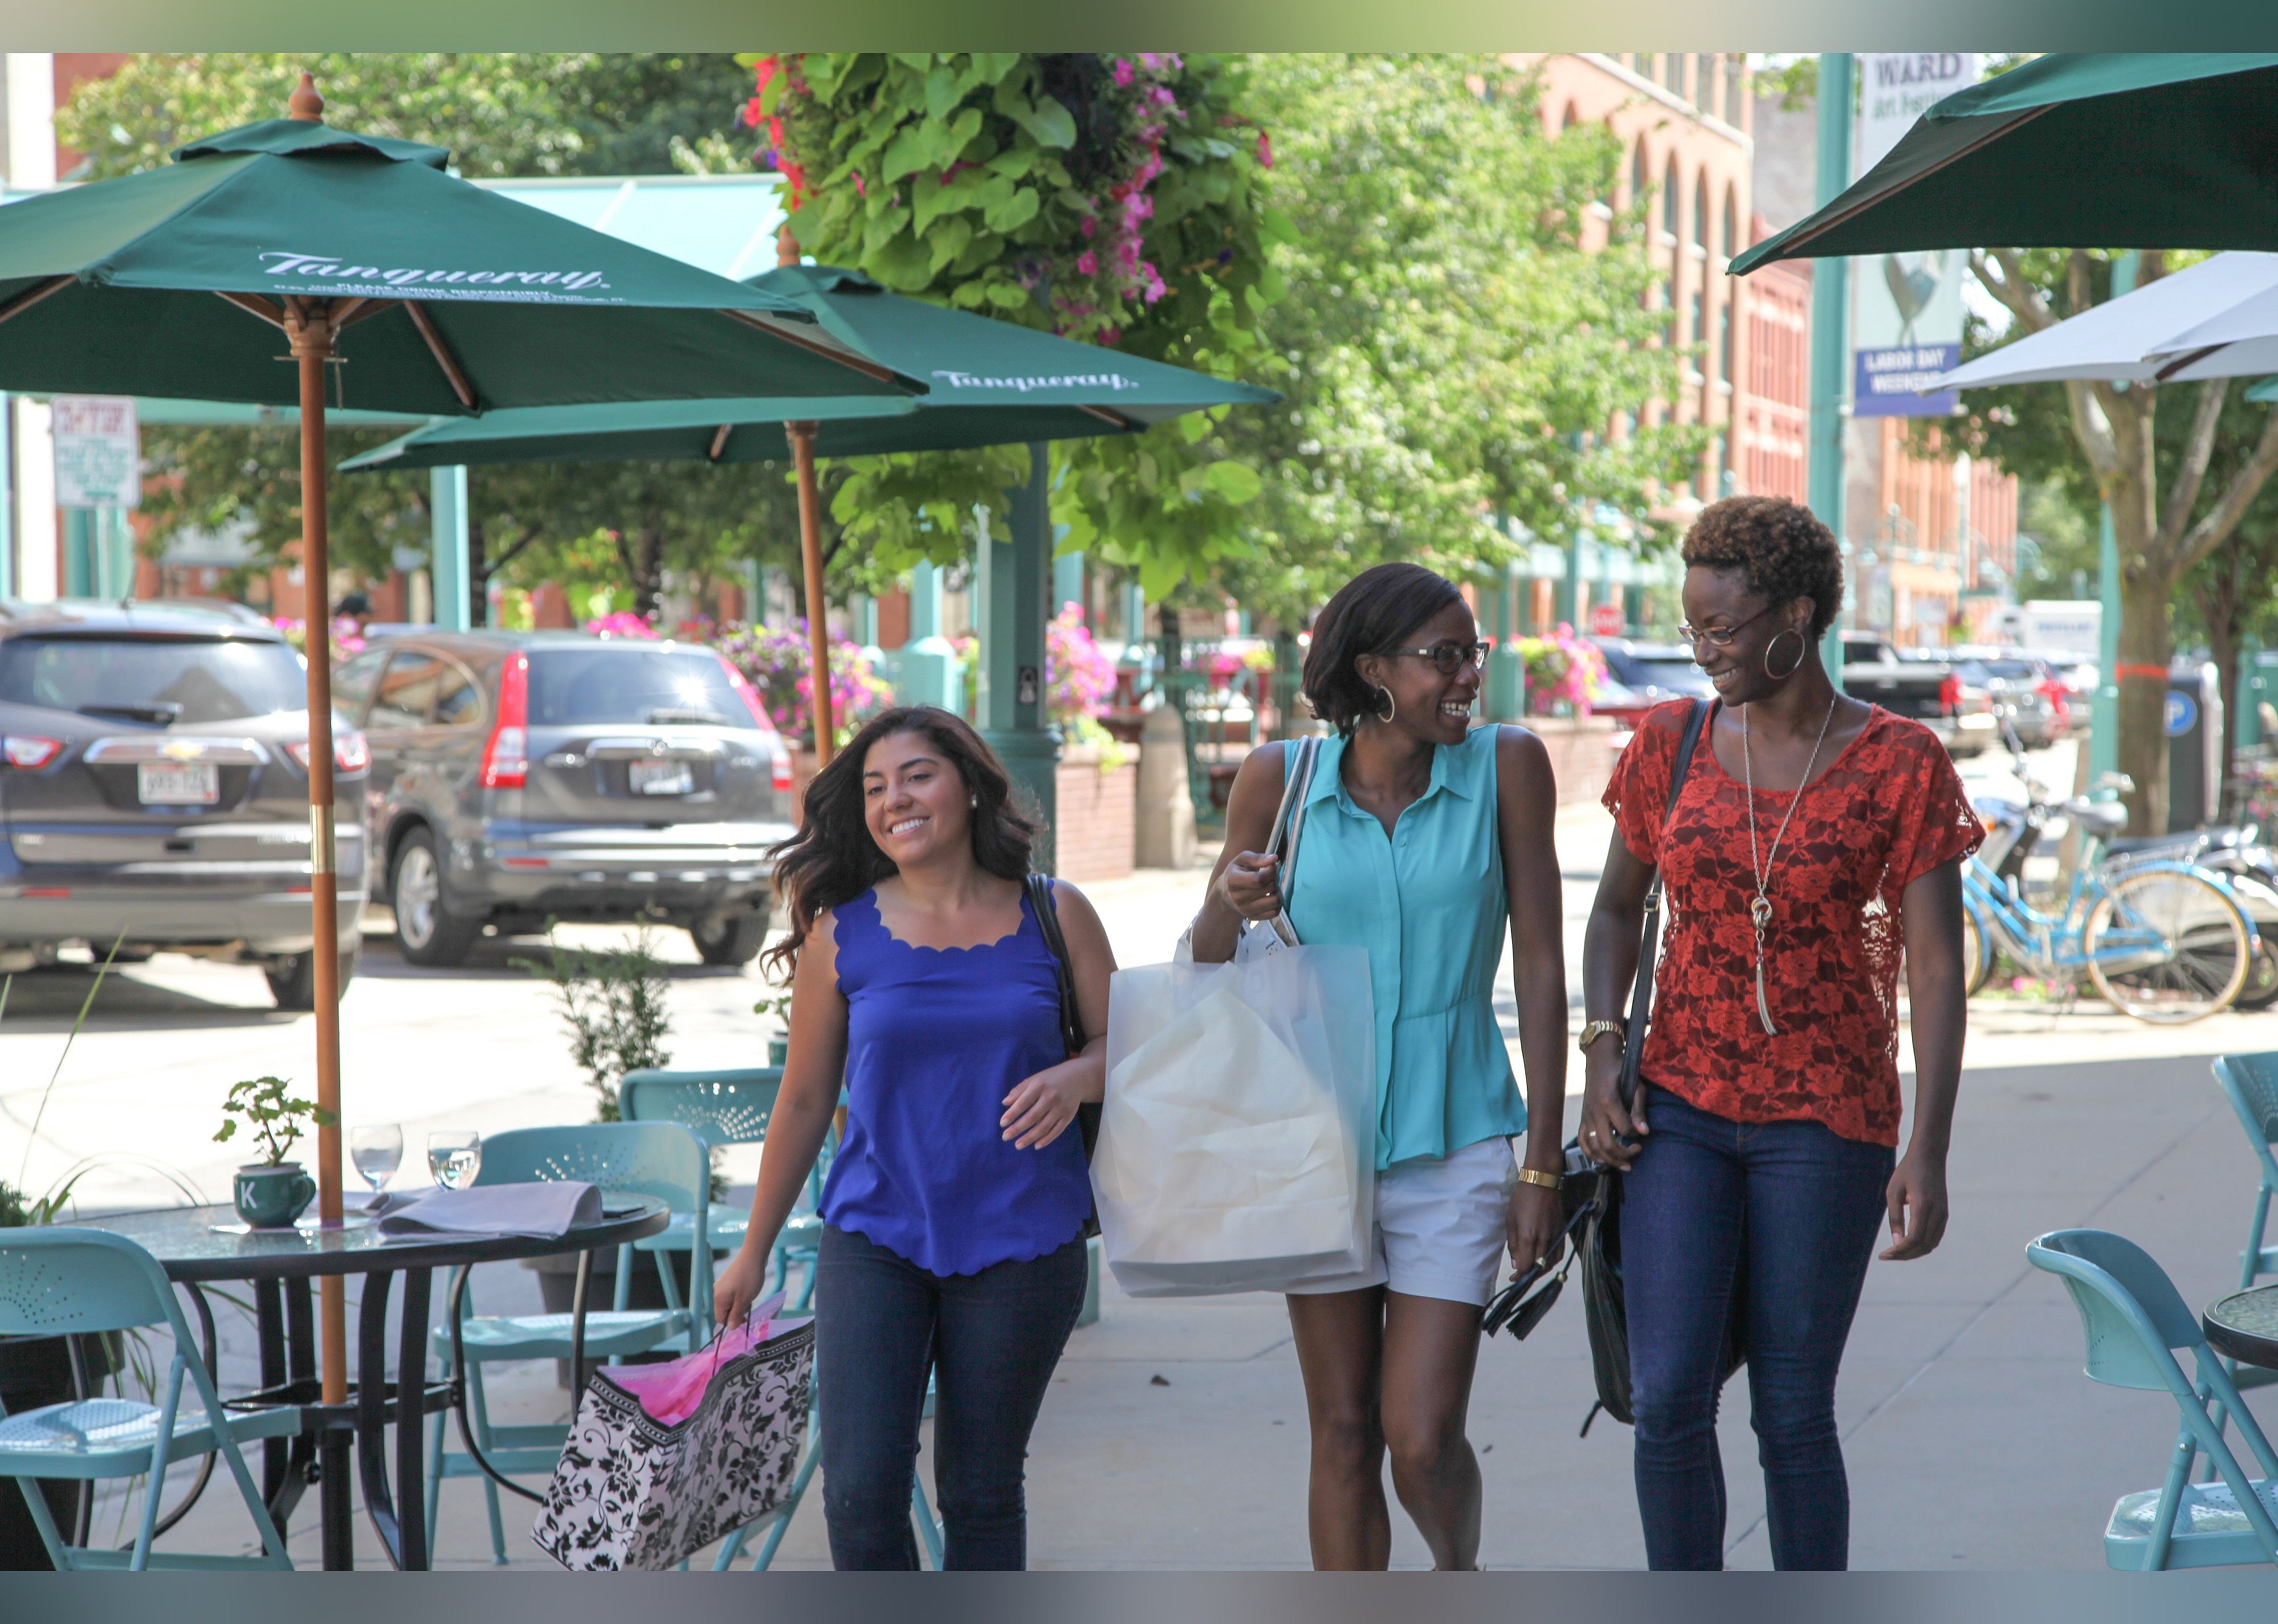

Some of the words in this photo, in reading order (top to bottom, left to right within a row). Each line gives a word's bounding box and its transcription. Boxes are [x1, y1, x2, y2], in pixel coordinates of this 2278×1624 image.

[1875, 52, 1962, 86] WARD
[259, 251, 603, 290] Tanqueray
[1864, 349, 1915, 373] LABOR
[1916, 348, 1946, 369] DAY
[931, 370, 1130, 391] Tanqueray
[241, 1181, 257, 1209] K
